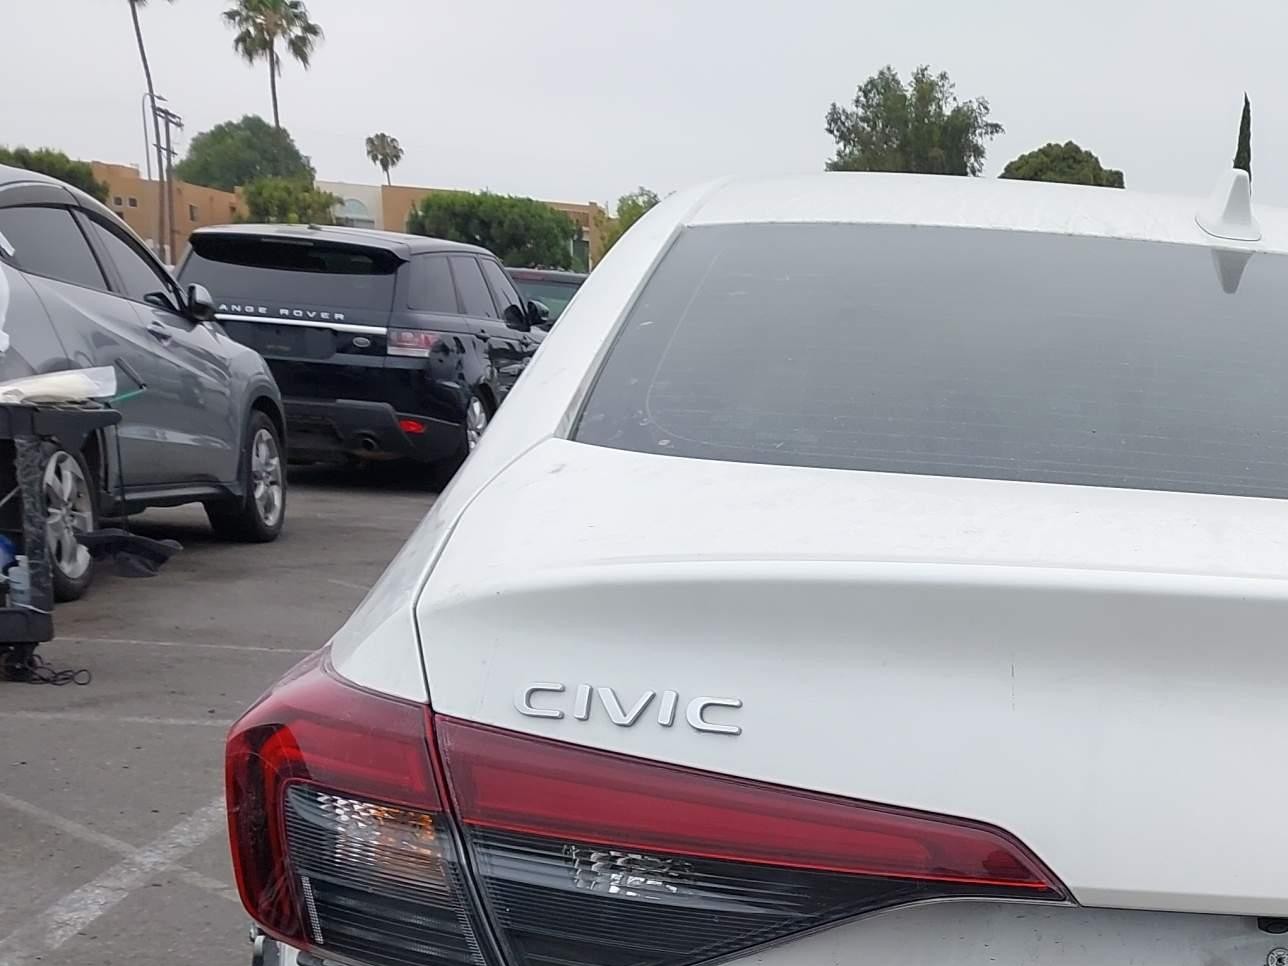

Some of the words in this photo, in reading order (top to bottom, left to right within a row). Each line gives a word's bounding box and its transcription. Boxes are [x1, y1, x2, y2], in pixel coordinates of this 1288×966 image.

[218, 303, 268, 314] ANGE
[279, 308, 345, 320] ROVER
[513, 681, 743, 735] CIVIC
